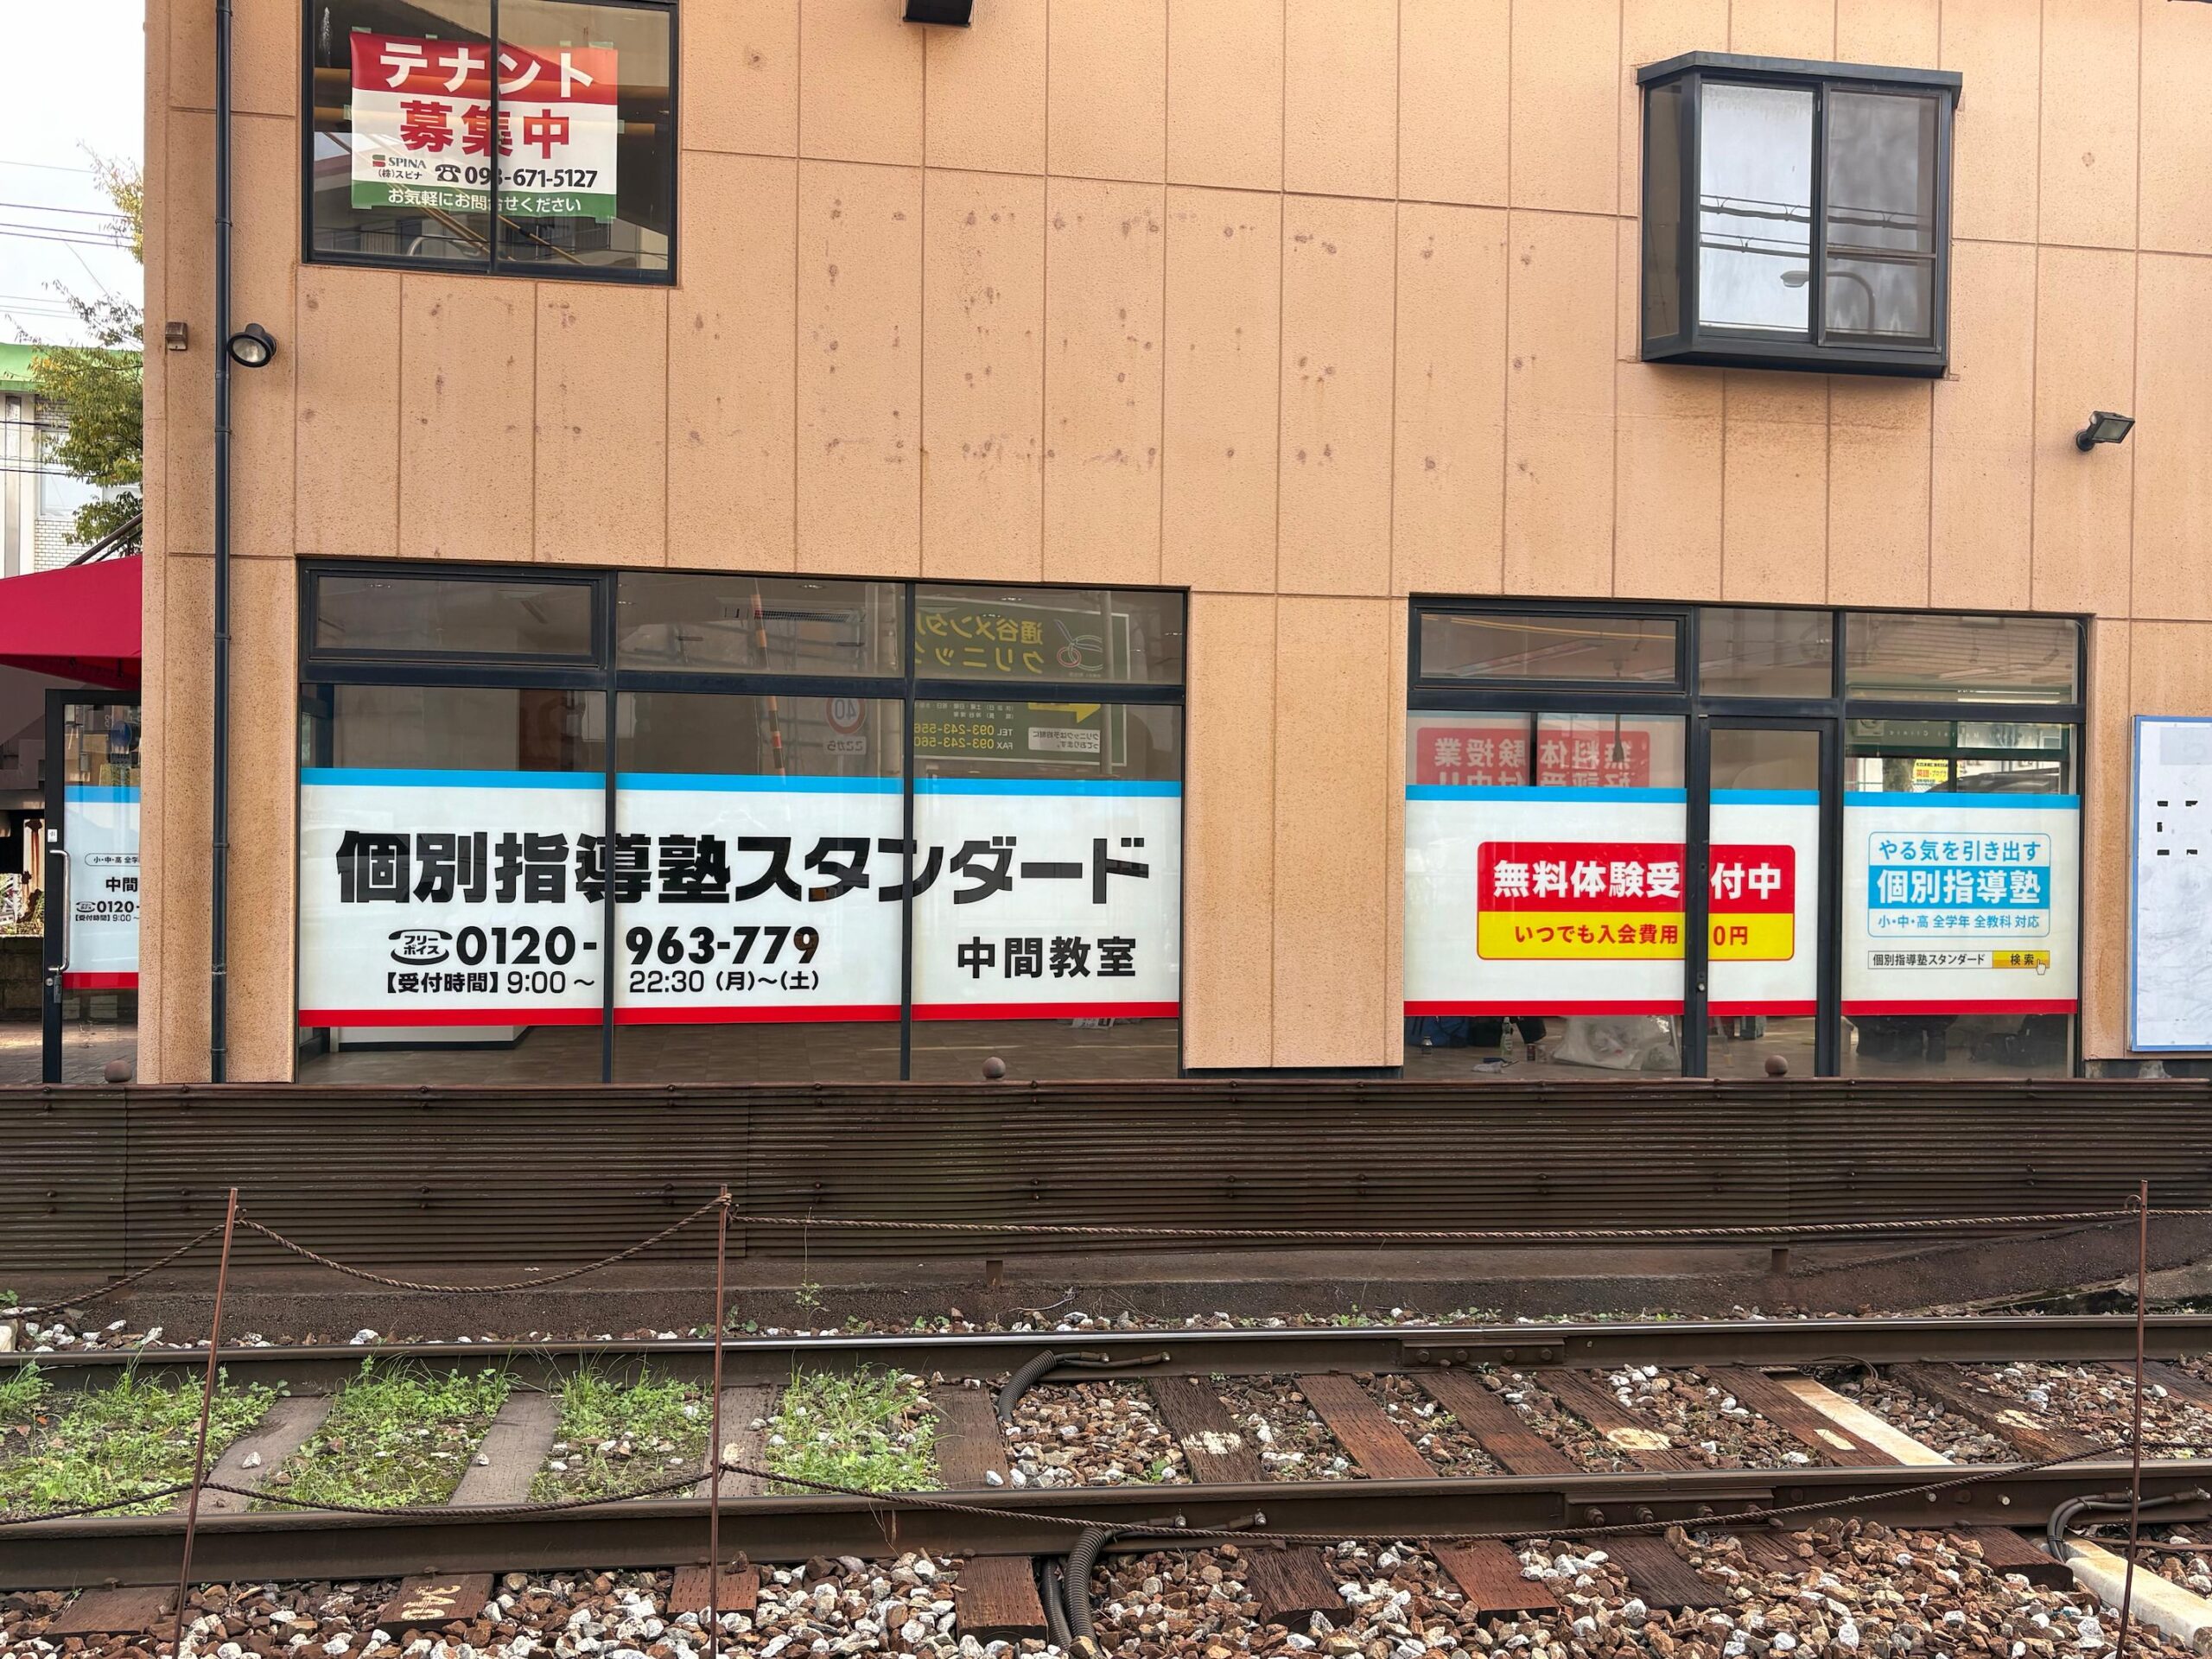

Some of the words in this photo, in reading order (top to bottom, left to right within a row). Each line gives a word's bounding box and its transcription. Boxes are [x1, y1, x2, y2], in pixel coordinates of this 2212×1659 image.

[380, 42, 594, 98] テナント
[400, 100, 569, 159] 募集中
[388, 156, 427, 169] SPINA
[1878, 840, 2041, 862] やる気を引き出す
[336, 830, 1149, 905] 個別指導塾スタンダード
[105, 876, 138, 893] 中間
[1877, 869, 2041, 904] 個別指導塾
[404, 935, 438, 945] フリー
[404, 944, 440, 955] ボイス
[957, 936, 1136, 978] 中間教室
[1873, 954, 1986, 966] 個別指導塾スタンダード
[2011, 954, 2035, 966] 検索
